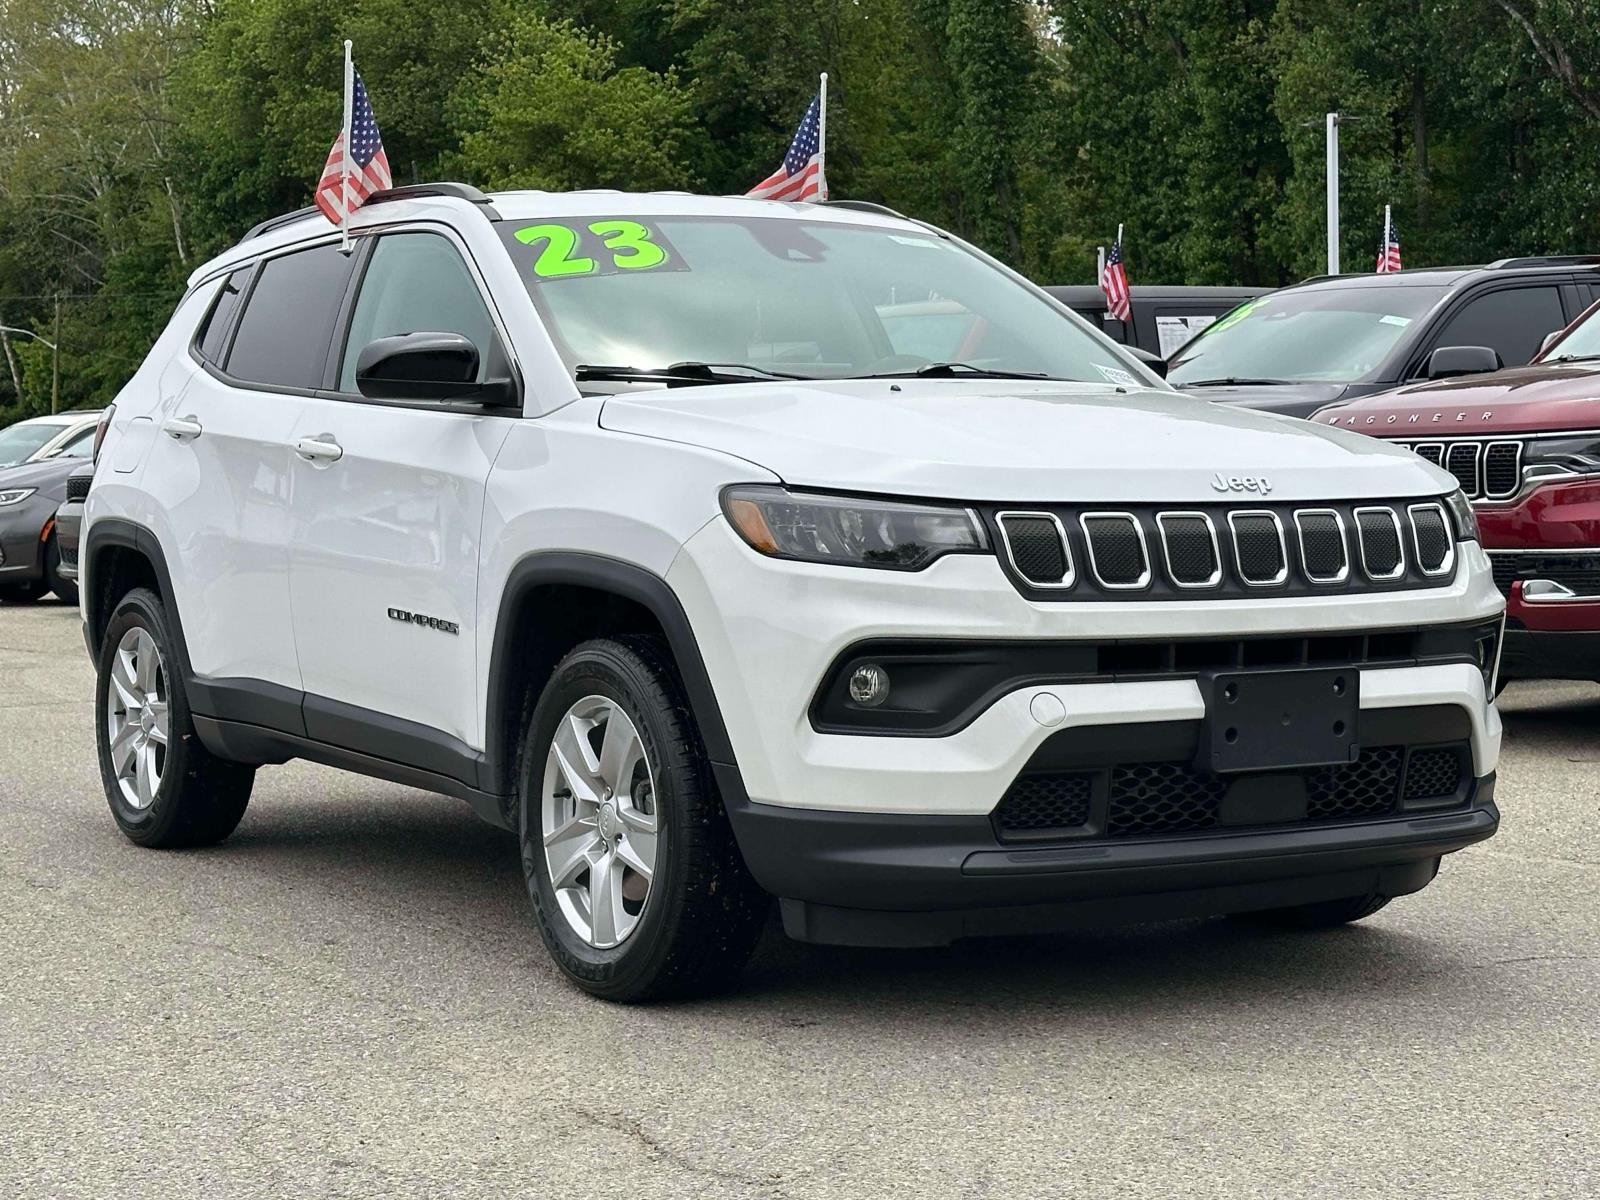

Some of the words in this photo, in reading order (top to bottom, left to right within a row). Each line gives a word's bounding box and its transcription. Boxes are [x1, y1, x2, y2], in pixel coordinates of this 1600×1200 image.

[514, 221, 666, 277] 23
[1328, 411, 1493, 425] WAGONEER
[1211, 472, 1272, 495] Jeep
[387, 607, 460, 635] COMPASS
